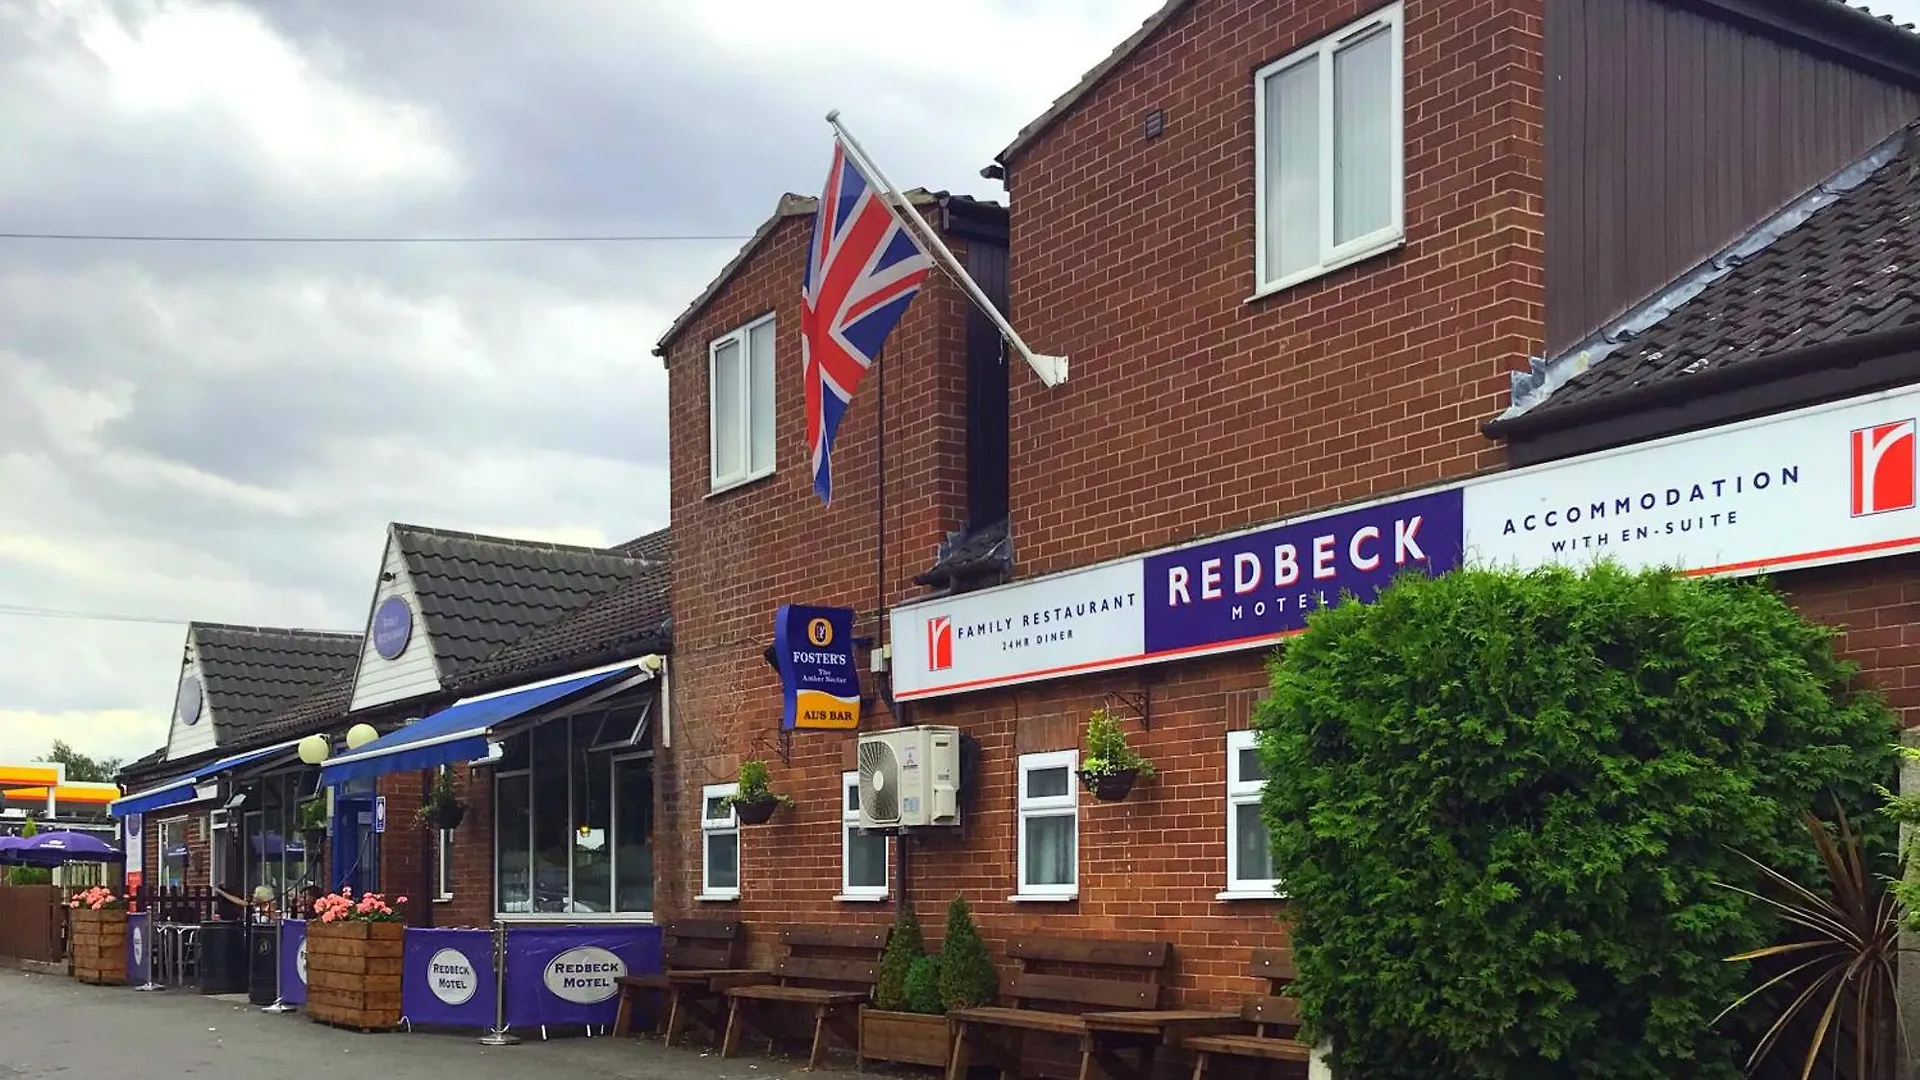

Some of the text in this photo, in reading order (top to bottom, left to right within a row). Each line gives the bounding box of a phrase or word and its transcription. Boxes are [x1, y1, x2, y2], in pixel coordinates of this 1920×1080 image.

[1503, 465, 1799, 535] ACCOMMODATION
[1551, 511, 1738, 554] WITH EN-SUITE
[1168, 515, 1426, 607] REDBECK
[1231, 590, 1329, 621] MOTEL
[958, 592, 1137, 640] FAMILY RESTAURANT
[1002, 629, 1074, 651] 24HR DINER
[793, 651, 846, 665] FOSTER'S
[829, 710, 853, 721] BAR
[433, 963, 470, 976] REDBECK
[554, 962, 619, 974] REDBECK
[438, 978, 467, 990] MOTEL
[563, 977, 610, 988] MOTEL
